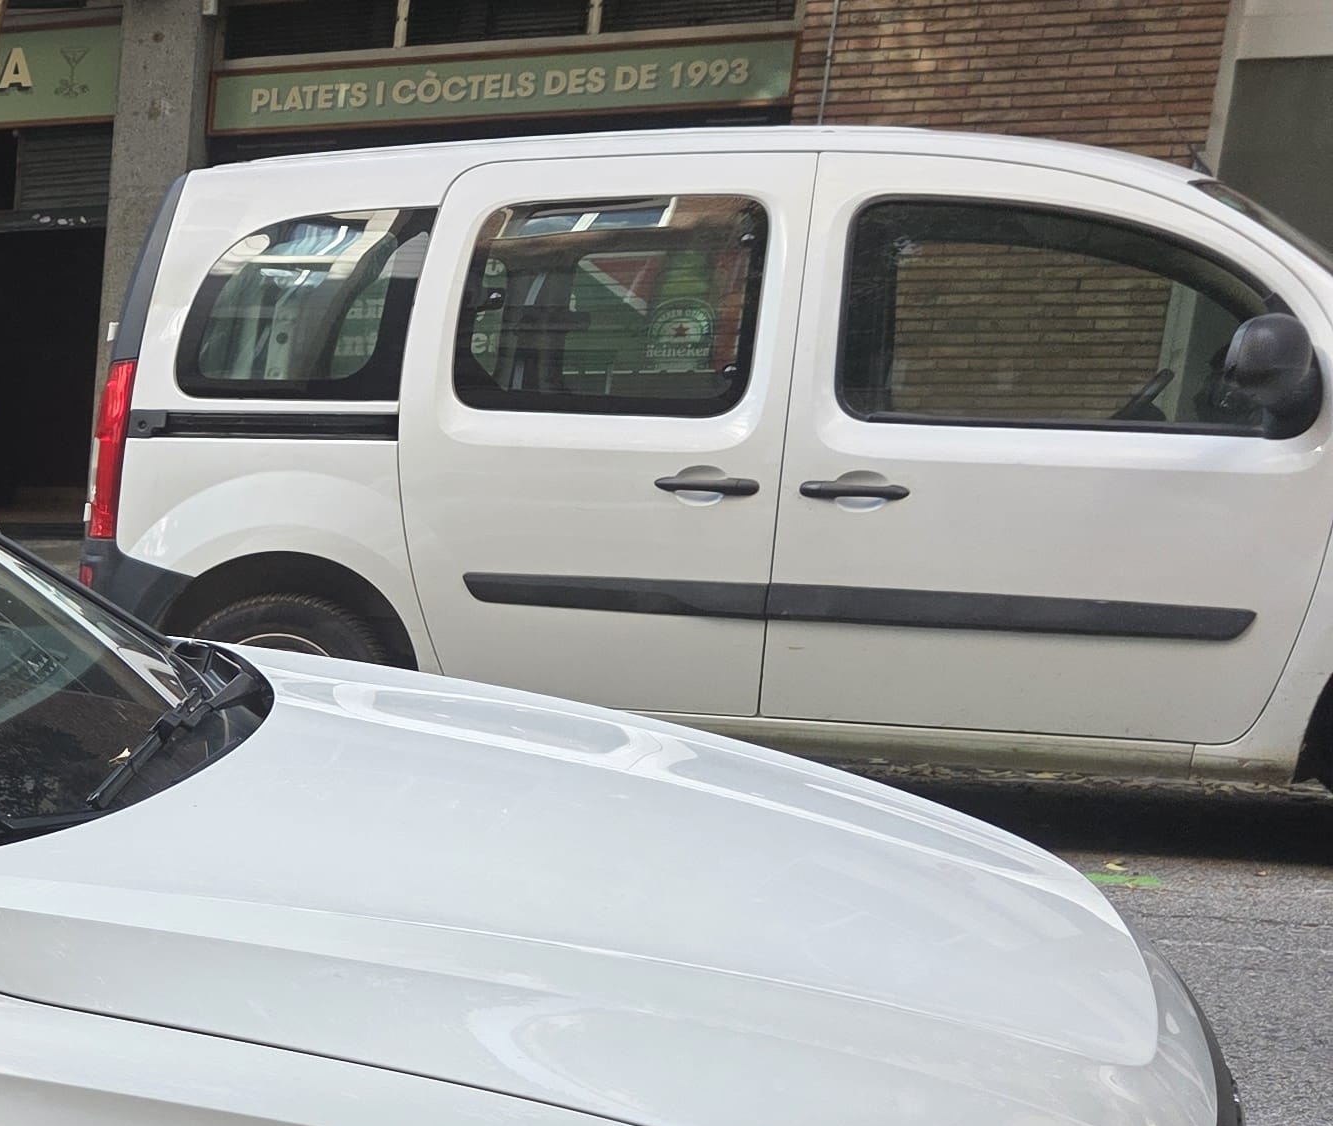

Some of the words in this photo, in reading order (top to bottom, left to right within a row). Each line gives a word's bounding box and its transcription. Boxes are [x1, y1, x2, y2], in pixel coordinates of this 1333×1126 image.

[251, 82, 367, 113] PLATETS
[375, 81, 385, 106] I
[392, 70, 535, 104] CÒCTELS
[544, 67, 606, 96] DES
[614, 64, 658, 92] DE
[669, 58, 749, 88] 1993
